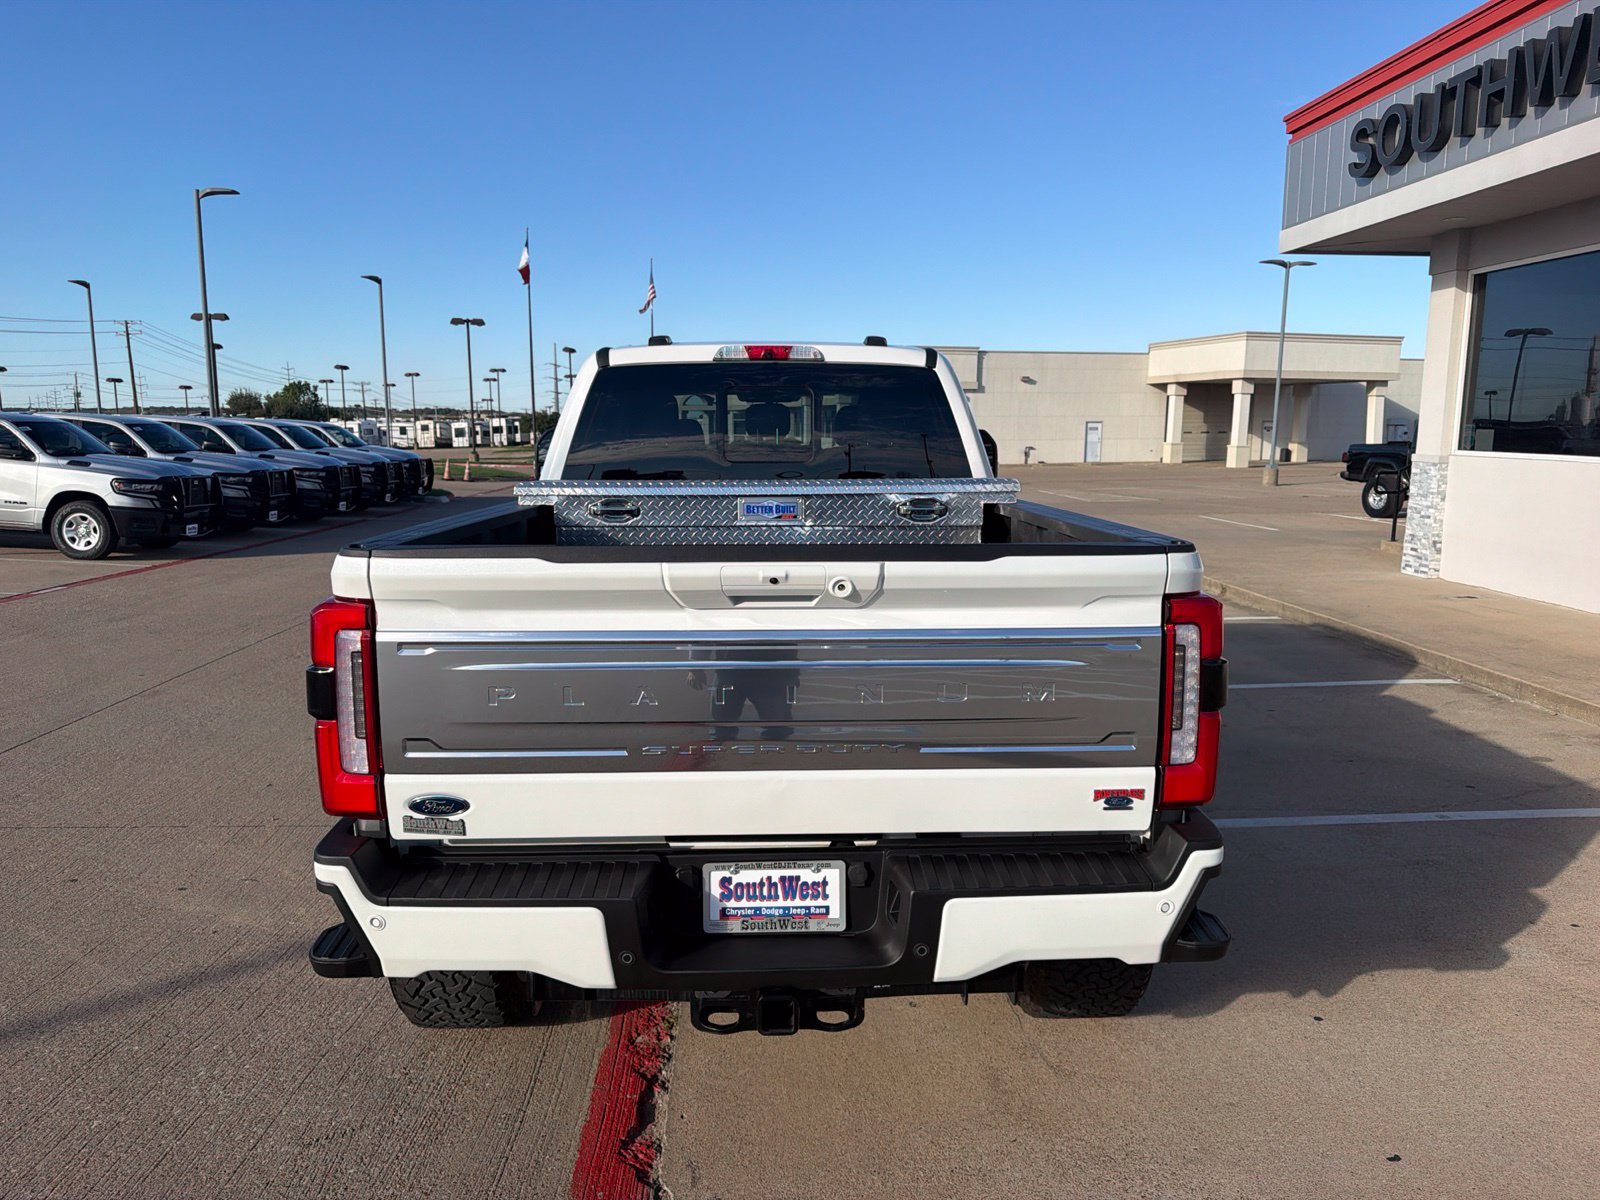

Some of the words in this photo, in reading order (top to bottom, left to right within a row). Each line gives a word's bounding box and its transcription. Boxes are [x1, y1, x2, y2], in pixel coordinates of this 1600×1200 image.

[746, 504, 774, 514] BETTER
[775, 504, 796, 514] BUILT
[488, 682, 1056, 706] PLATINUM
[642, 744, 785, 755] SUPER
[797, 743, 905, 753] DUTY
[422, 800, 455, 812] Ford
[403, 816, 463, 829] SouthWest
[715, 862, 831, 870] wwwSouthWestCDJRTexascom
[719, 875, 829, 902] SouthWest
[726, 908, 755, 916] Chrysler
[761, 907, 783, 916] Dodge
[789, 907, 806, 915] Jeep
[740, 919, 810, 931] SouthWest
